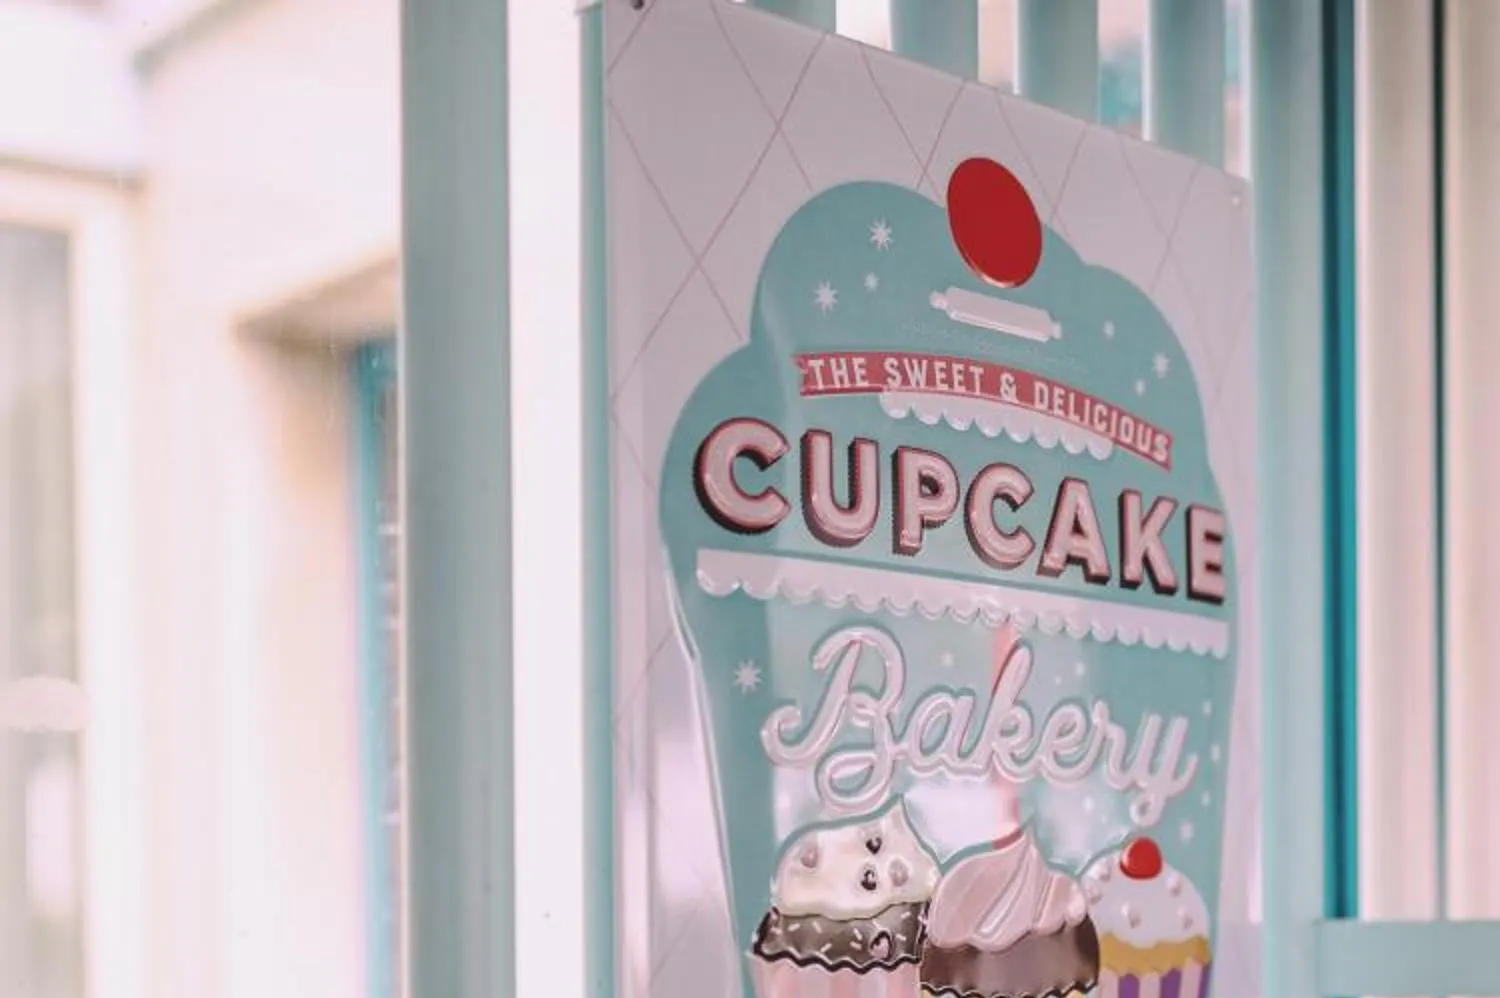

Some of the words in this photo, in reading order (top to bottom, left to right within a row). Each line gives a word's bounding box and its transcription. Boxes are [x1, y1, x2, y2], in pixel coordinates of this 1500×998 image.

[807, 355, 869, 391] THE
[882, 357, 985, 395] SWEET
[999, 371, 1020, 404] &
[1034, 379, 1170, 465] DELICIOUS
[693, 416, 1227, 606] CUPCAKE
[760, 625, 1198, 828] Bakery
